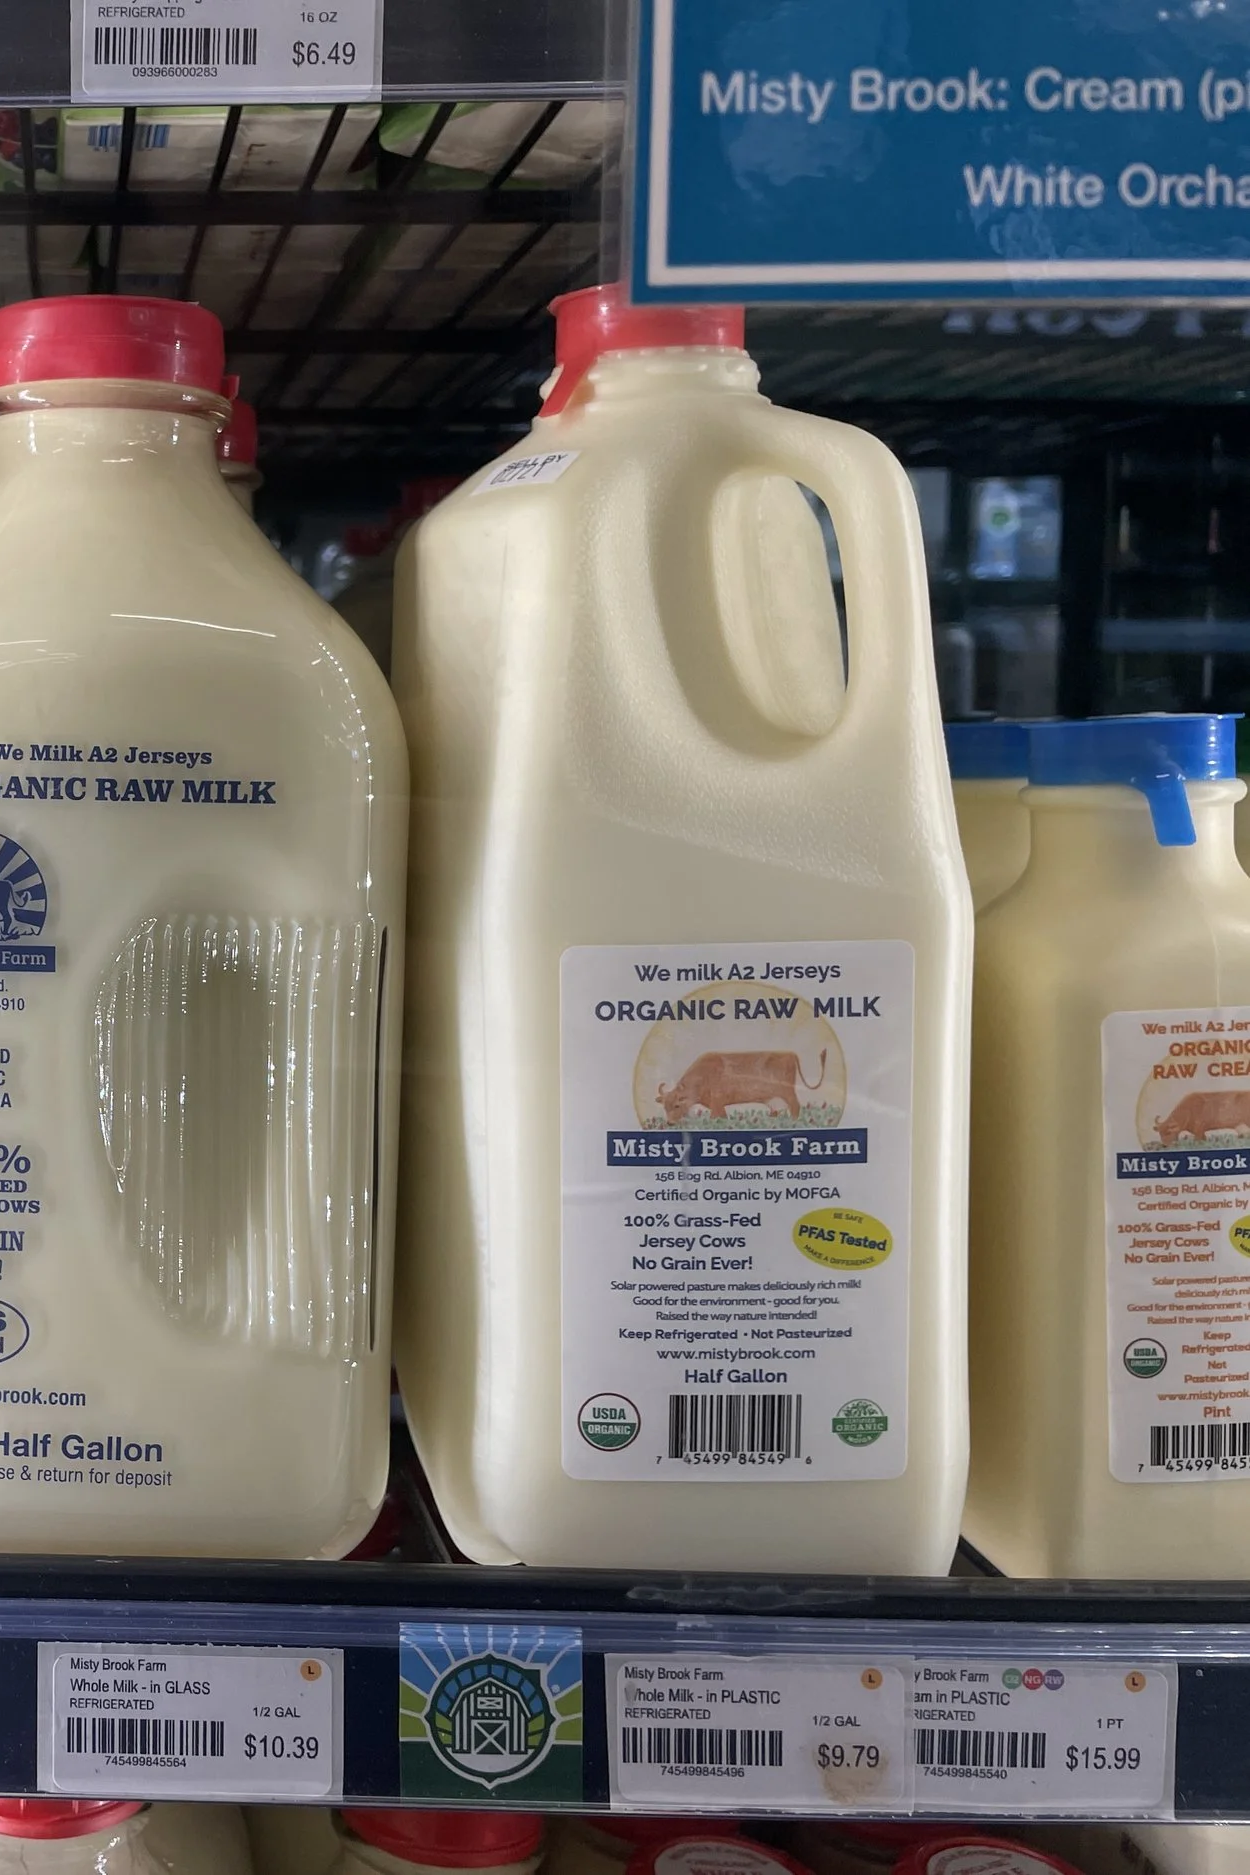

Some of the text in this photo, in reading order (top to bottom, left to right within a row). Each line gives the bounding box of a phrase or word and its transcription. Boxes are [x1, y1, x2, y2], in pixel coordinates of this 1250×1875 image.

[98, 7, 185, 18] REFRIGERATED
[300, 12, 337, 23] 16 OZ
[292, 40, 356, 67] $6.49
[133, 67, 217, 77] 093966000283
[700, 71, 834, 124] Misty
[850, 68, 1009, 113] Brook:
[1026, 66, 1182, 111] Cream
[963, 165, 1104, 207] White
[30, 745, 82, 762] Milk
[87, 747, 117, 763] A2
[124, 747, 213, 769] Jerseys
[95, 778, 174, 803] RAW
[181, 780, 276, 805] MILK
[1, 951, 46, 967] Farm
[634, 962, 841, 983] We milk A2 Jerseys
[595, 997, 881, 1022] ORGANIC RAW MILK
[1153, 1064, 1197, 1079] RAW
[612, 1137, 861, 1163] Misty Brook Farm
[1122, 1155, 1247, 1174] Misty Brook
[624, 1213, 761, 1228] 100% Grass-Fed
[639, 1234, 746, 1250] Jersey Cows
[632, 1256, 753, 1271] No Grain Ever!
[685, 1369, 788, 1383] Half Gallon
[1203, 1406, 1231, 1418] Pint
[61, 1435, 163, 1462] Gallon
[20, 1465, 32, 1481] &
[37, 1466, 83, 1483] return
[89, 1468, 110, 1484] for
[115, 1469, 172, 1488] deposit
[70, 1658, 167, 1672] Misty Brook Farm
[70, 1679, 109, 1692] Whole
[113, 1680, 138, 1693] Milk
[150, 1681, 161, 1693] in
[165, 1681, 210, 1695] GLASS
[70, 1698, 154, 1710] REFRIGERATED
[253, 1707, 300, 1718] 1/2 GAL
[244, 1734, 319, 1760] $10.39
[105, 1756, 187, 1767] 745499845564
[818, 1744, 880, 1769] $9.79
[1066, 1745, 1140, 1770] $15.99
